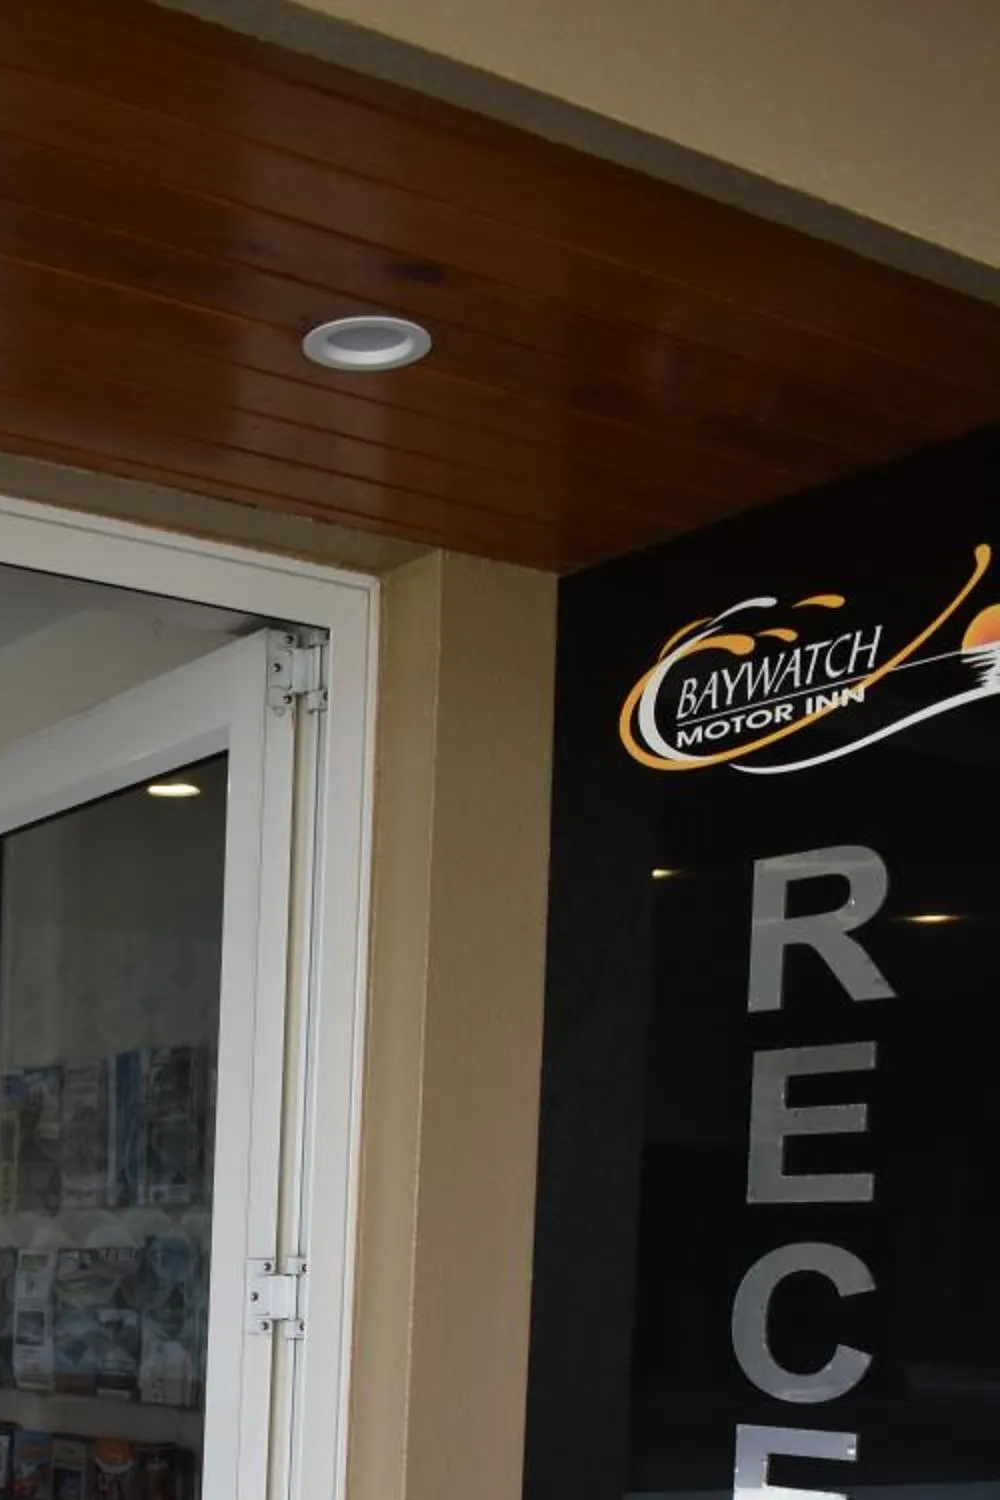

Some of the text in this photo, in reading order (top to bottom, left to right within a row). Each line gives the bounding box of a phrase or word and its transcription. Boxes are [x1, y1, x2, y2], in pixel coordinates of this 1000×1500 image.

[676, 625, 883, 719] BAYWATCH
[676, 686, 867, 748] MOTOR INN
